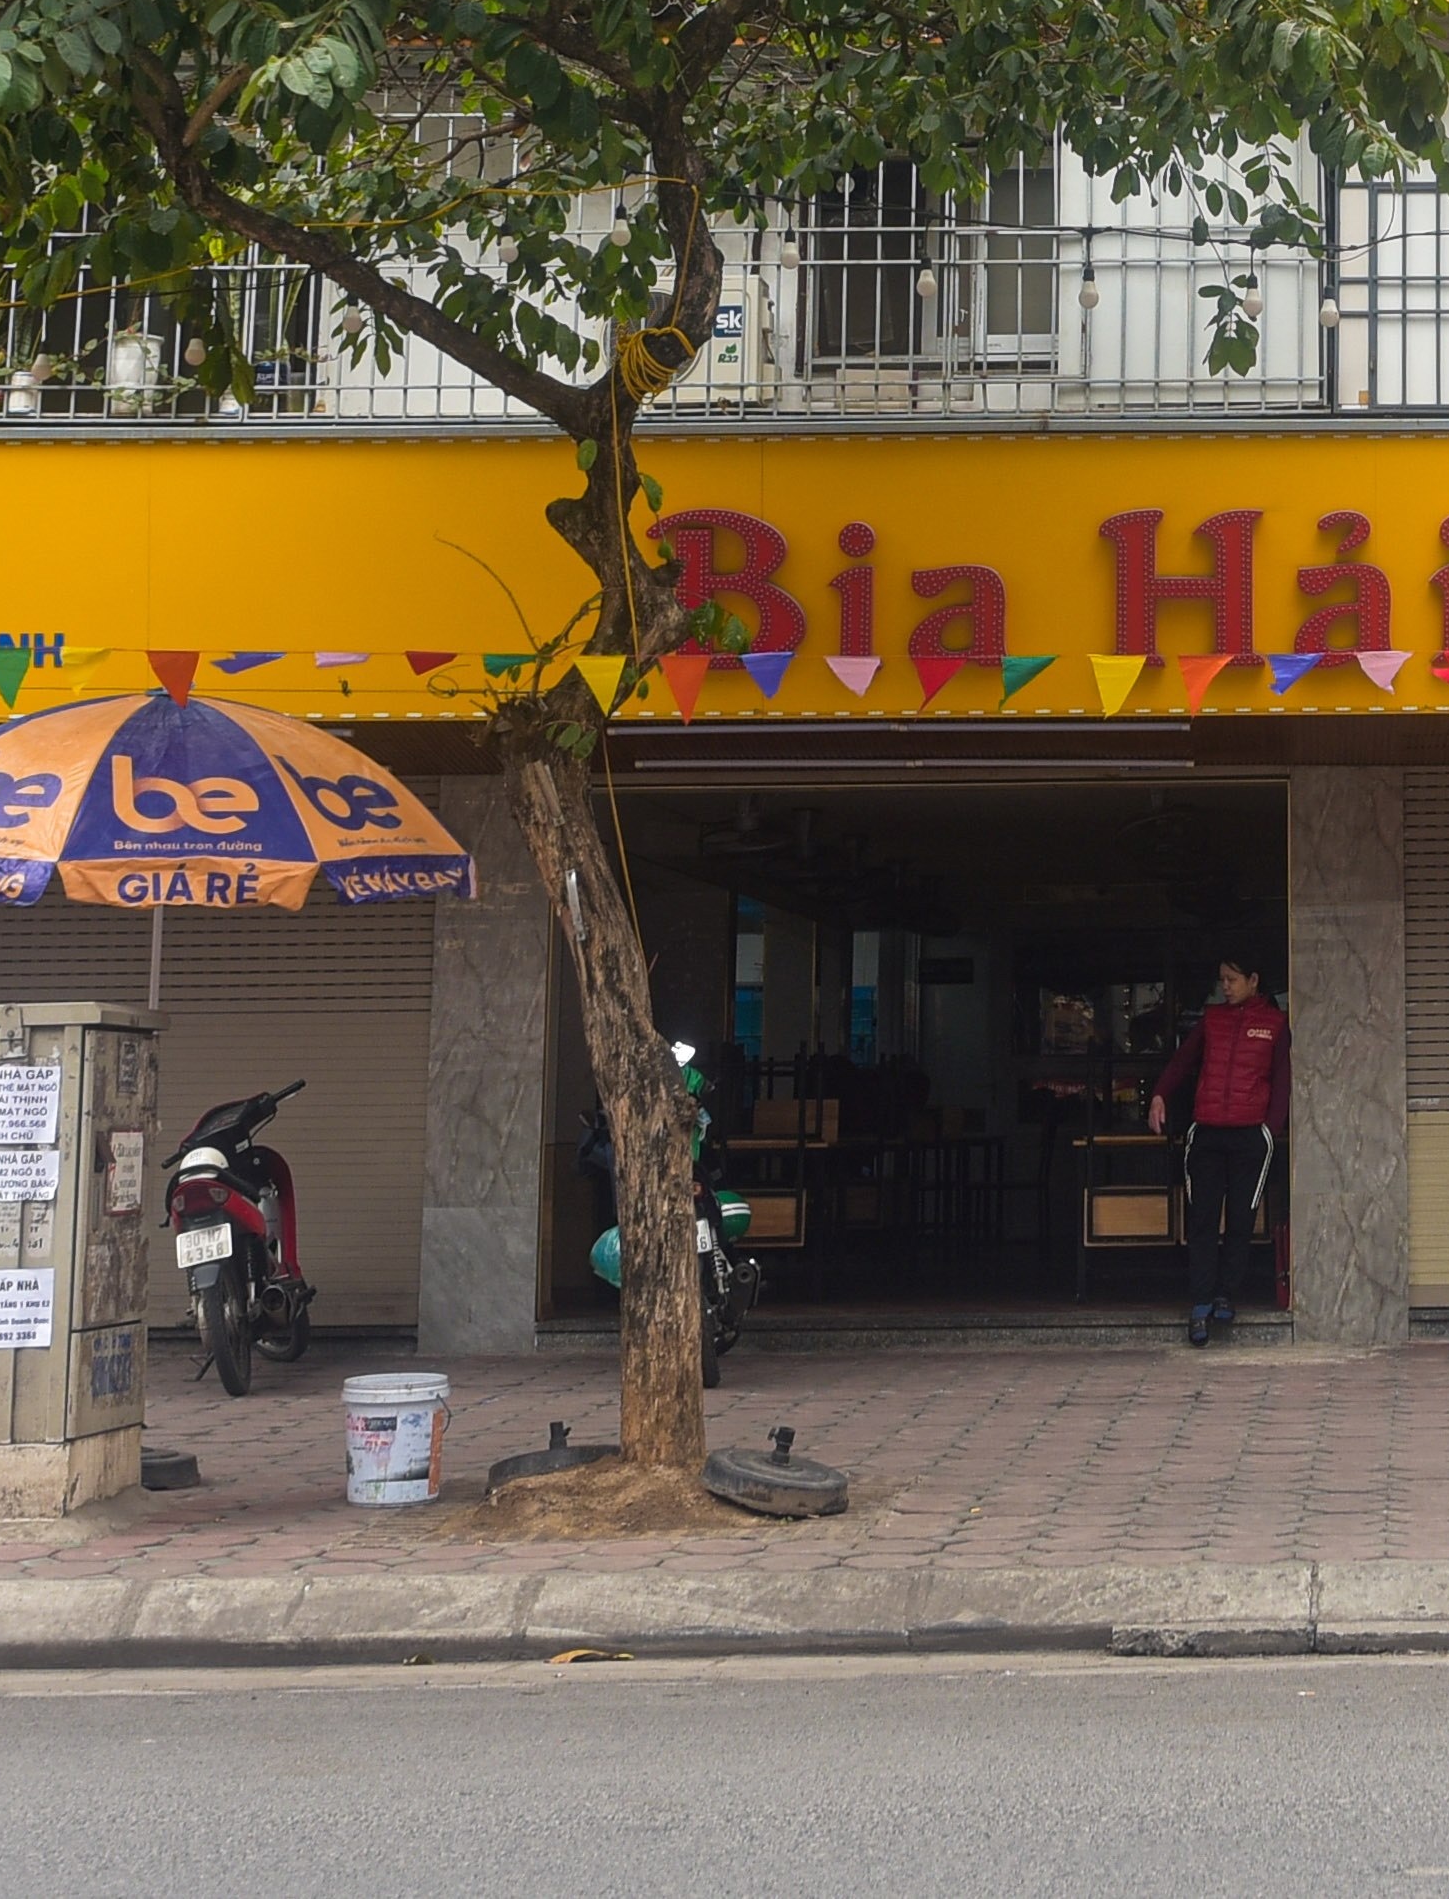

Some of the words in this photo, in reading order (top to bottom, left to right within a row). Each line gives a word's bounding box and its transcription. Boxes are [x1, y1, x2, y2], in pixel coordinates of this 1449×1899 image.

[646, 508, 1008, 671] Bia
[112, 754, 261, 835] be
[275, 753, 401, 829] be
[114, 838, 140, 851] Bên
[143, 840, 179, 851] nhau
[117, 861, 192, 903] GIÁ
[206, 862, 260, 904] RẺ
[12, 1095, 48, 1106] THỊNH
[10, 1166, 33, 1177] NGÕ
[16, 1277, 40, 1292] NHÀ
